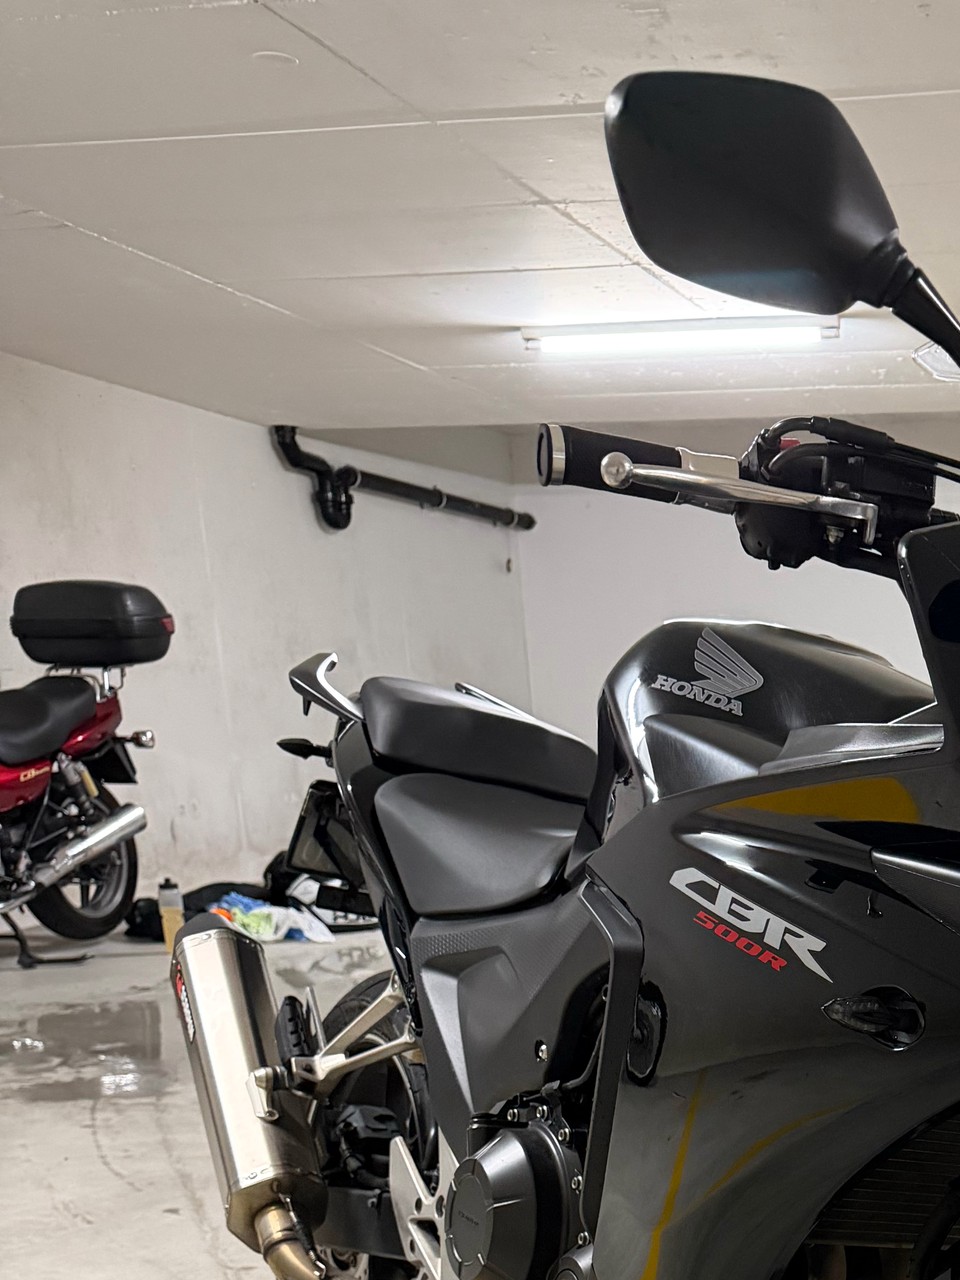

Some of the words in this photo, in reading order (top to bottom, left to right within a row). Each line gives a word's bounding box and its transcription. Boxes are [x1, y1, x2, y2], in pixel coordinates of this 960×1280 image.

[651, 673, 744, 717] HONDA
[668, 866, 834, 984] CBR
[693, 910, 788, 972] 500R
